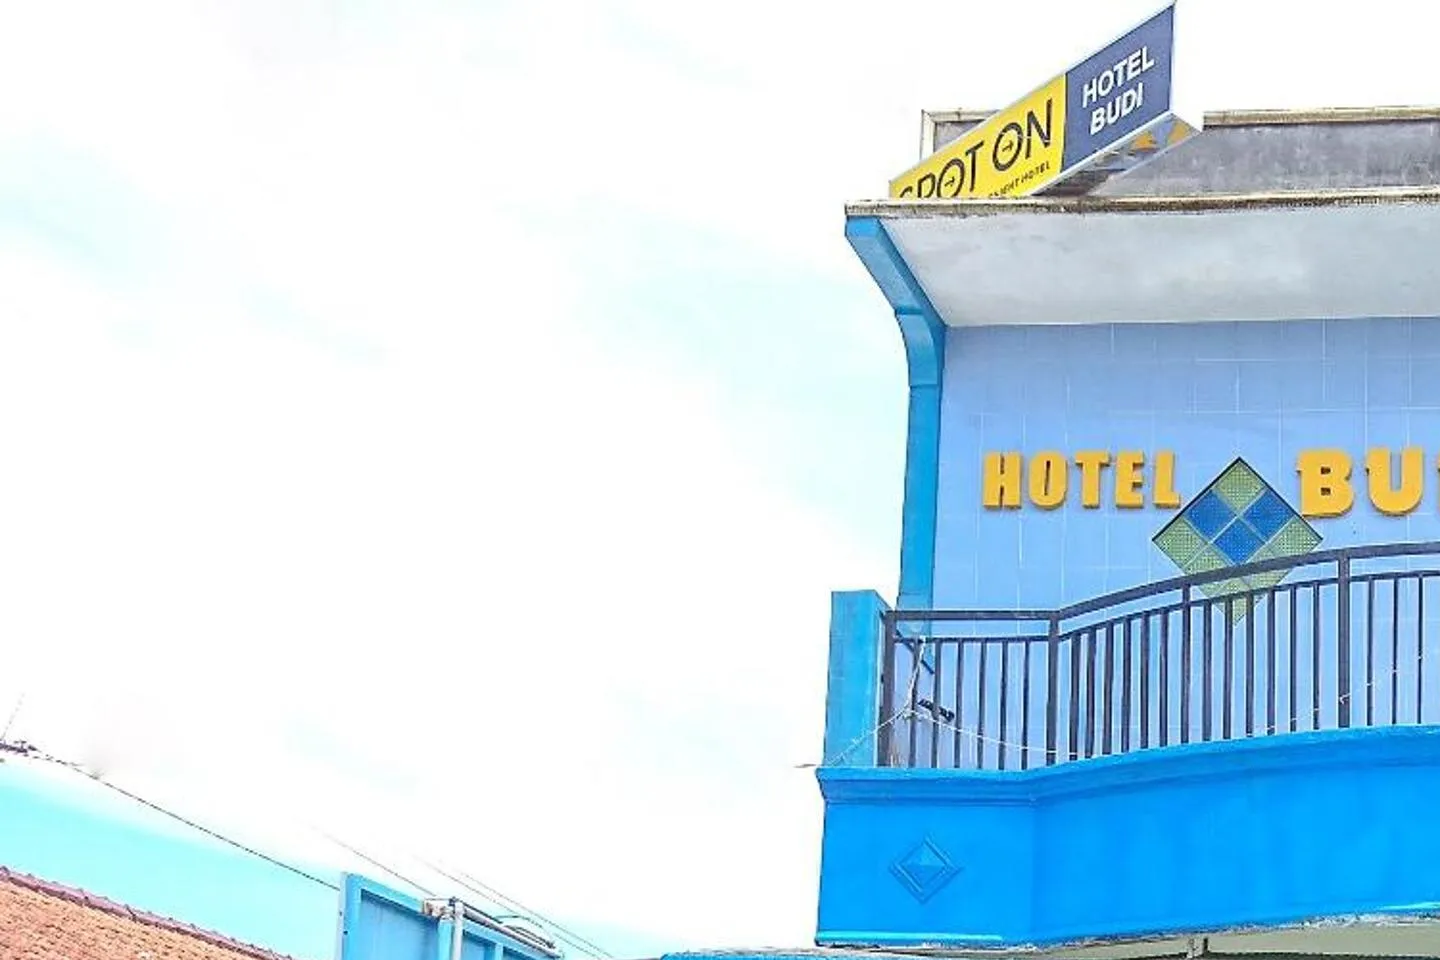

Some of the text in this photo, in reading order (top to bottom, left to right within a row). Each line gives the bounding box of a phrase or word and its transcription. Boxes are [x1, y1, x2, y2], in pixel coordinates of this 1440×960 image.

[1082, 46, 1155, 108] HOTEL
[1090, 82, 1143, 136] BUDI
[900, 98, 1053, 198] POT ON
[1021, 160, 1051, 183] HOTEL
[982, 449, 1181, 509] HOTEL
